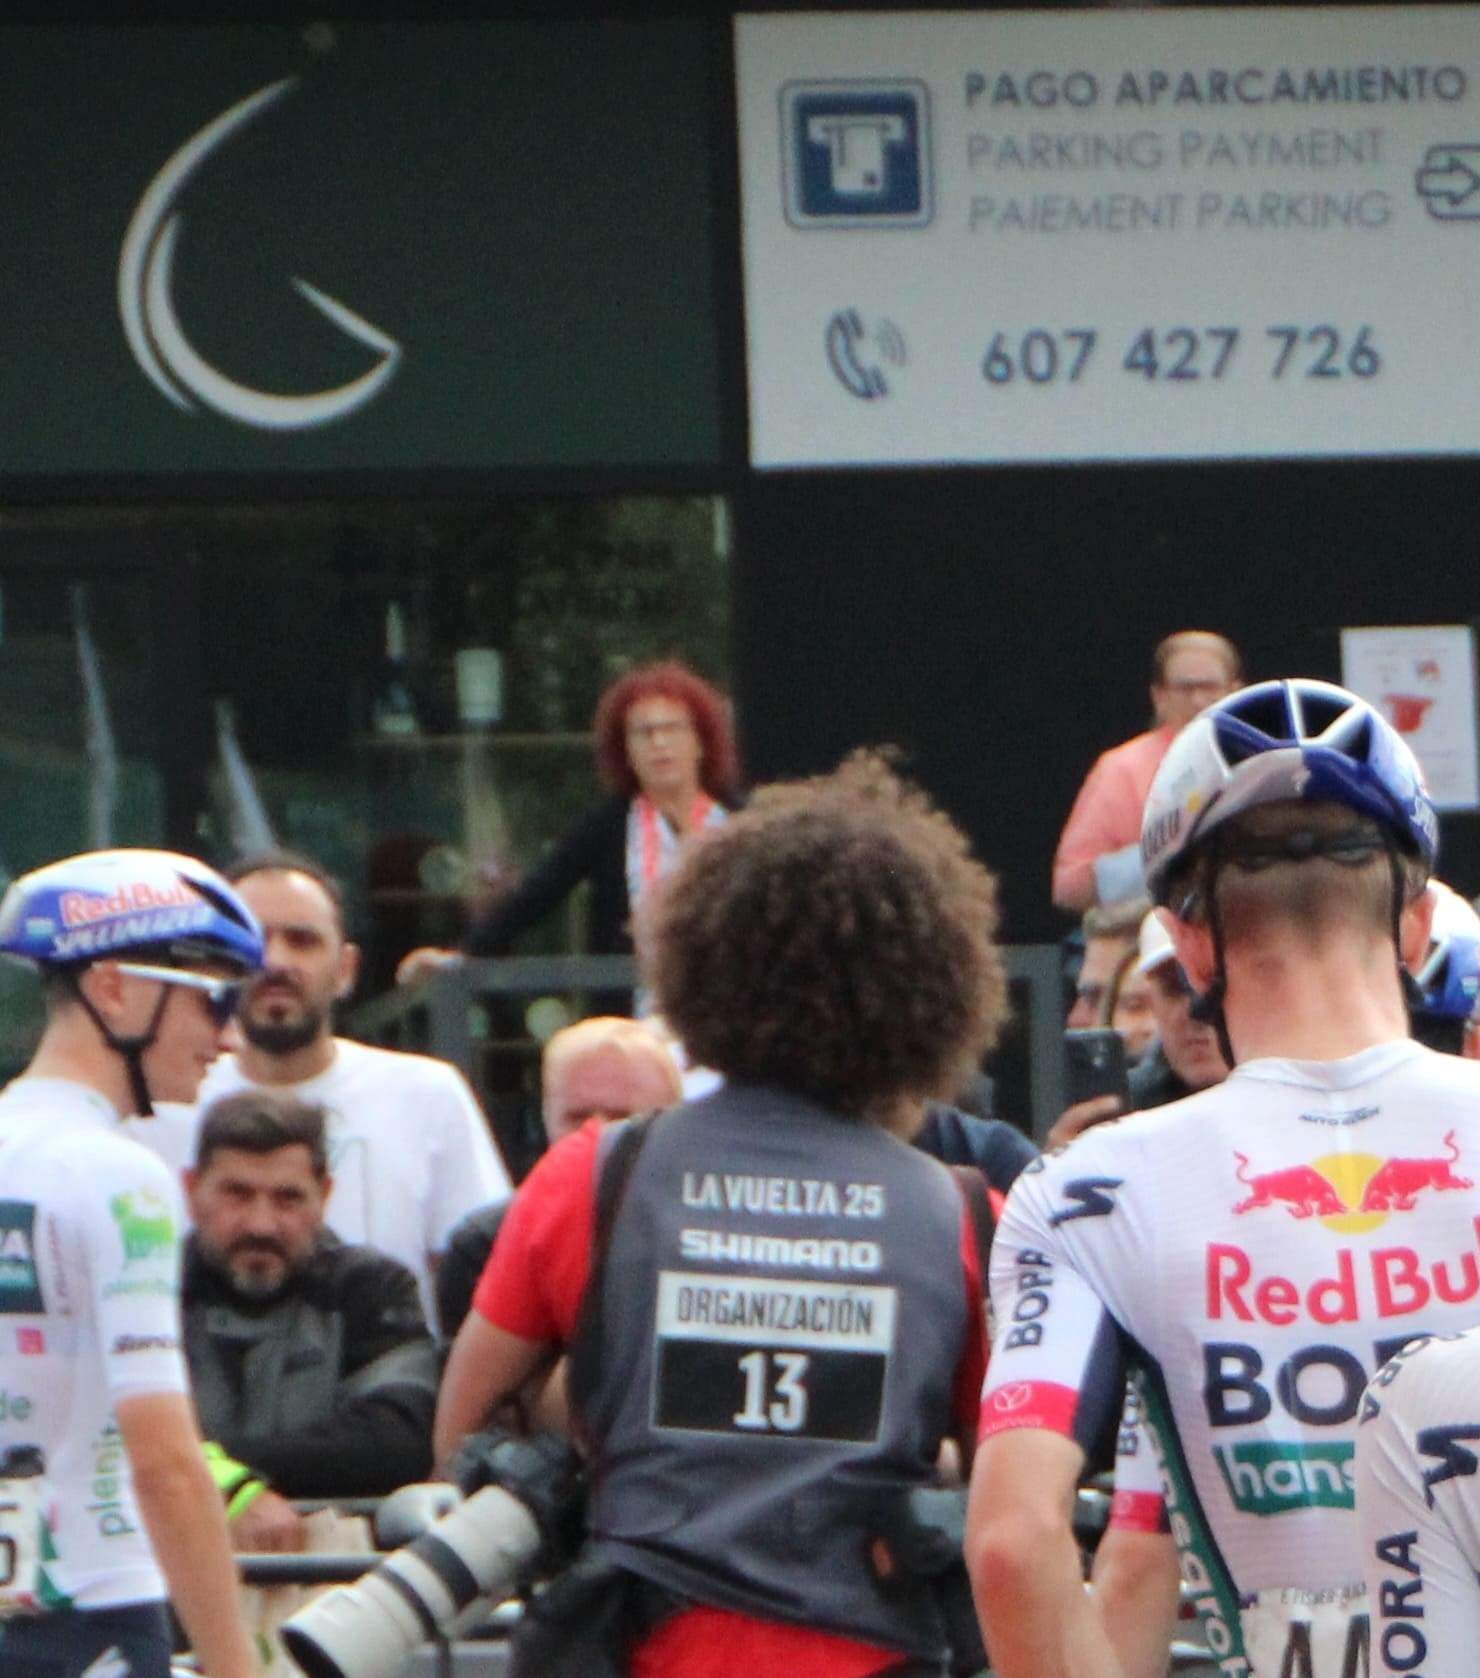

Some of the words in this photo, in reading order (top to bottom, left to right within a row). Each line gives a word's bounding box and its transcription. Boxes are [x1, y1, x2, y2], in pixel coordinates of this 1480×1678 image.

[964, 70, 1099, 109] PAGO
[1115, 65, 1465, 106] APARCAMIENTO
[967, 132, 1164, 172] PARKING
[1178, 129, 1384, 167] PAYMENT
[969, 195, 1185, 233] PAIEMENT
[1199, 191, 1393, 231] PARKING
[981, 330, 1099, 385] 607
[1123, 328, 1241, 382] 427
[1267, 326, 1382, 380] 726
[683, 1172, 721, 1206] LA
[723, 1174, 838, 1218] VUELTA
[844, 1184, 886, 1219] 25
[679, 1228, 882, 1271] SHIMANO
[1206, 1242, 1360, 1327] Red
[677, 1286, 873, 1337] ORGANIZACIÓN
[733, 1351, 811, 1431] 13
